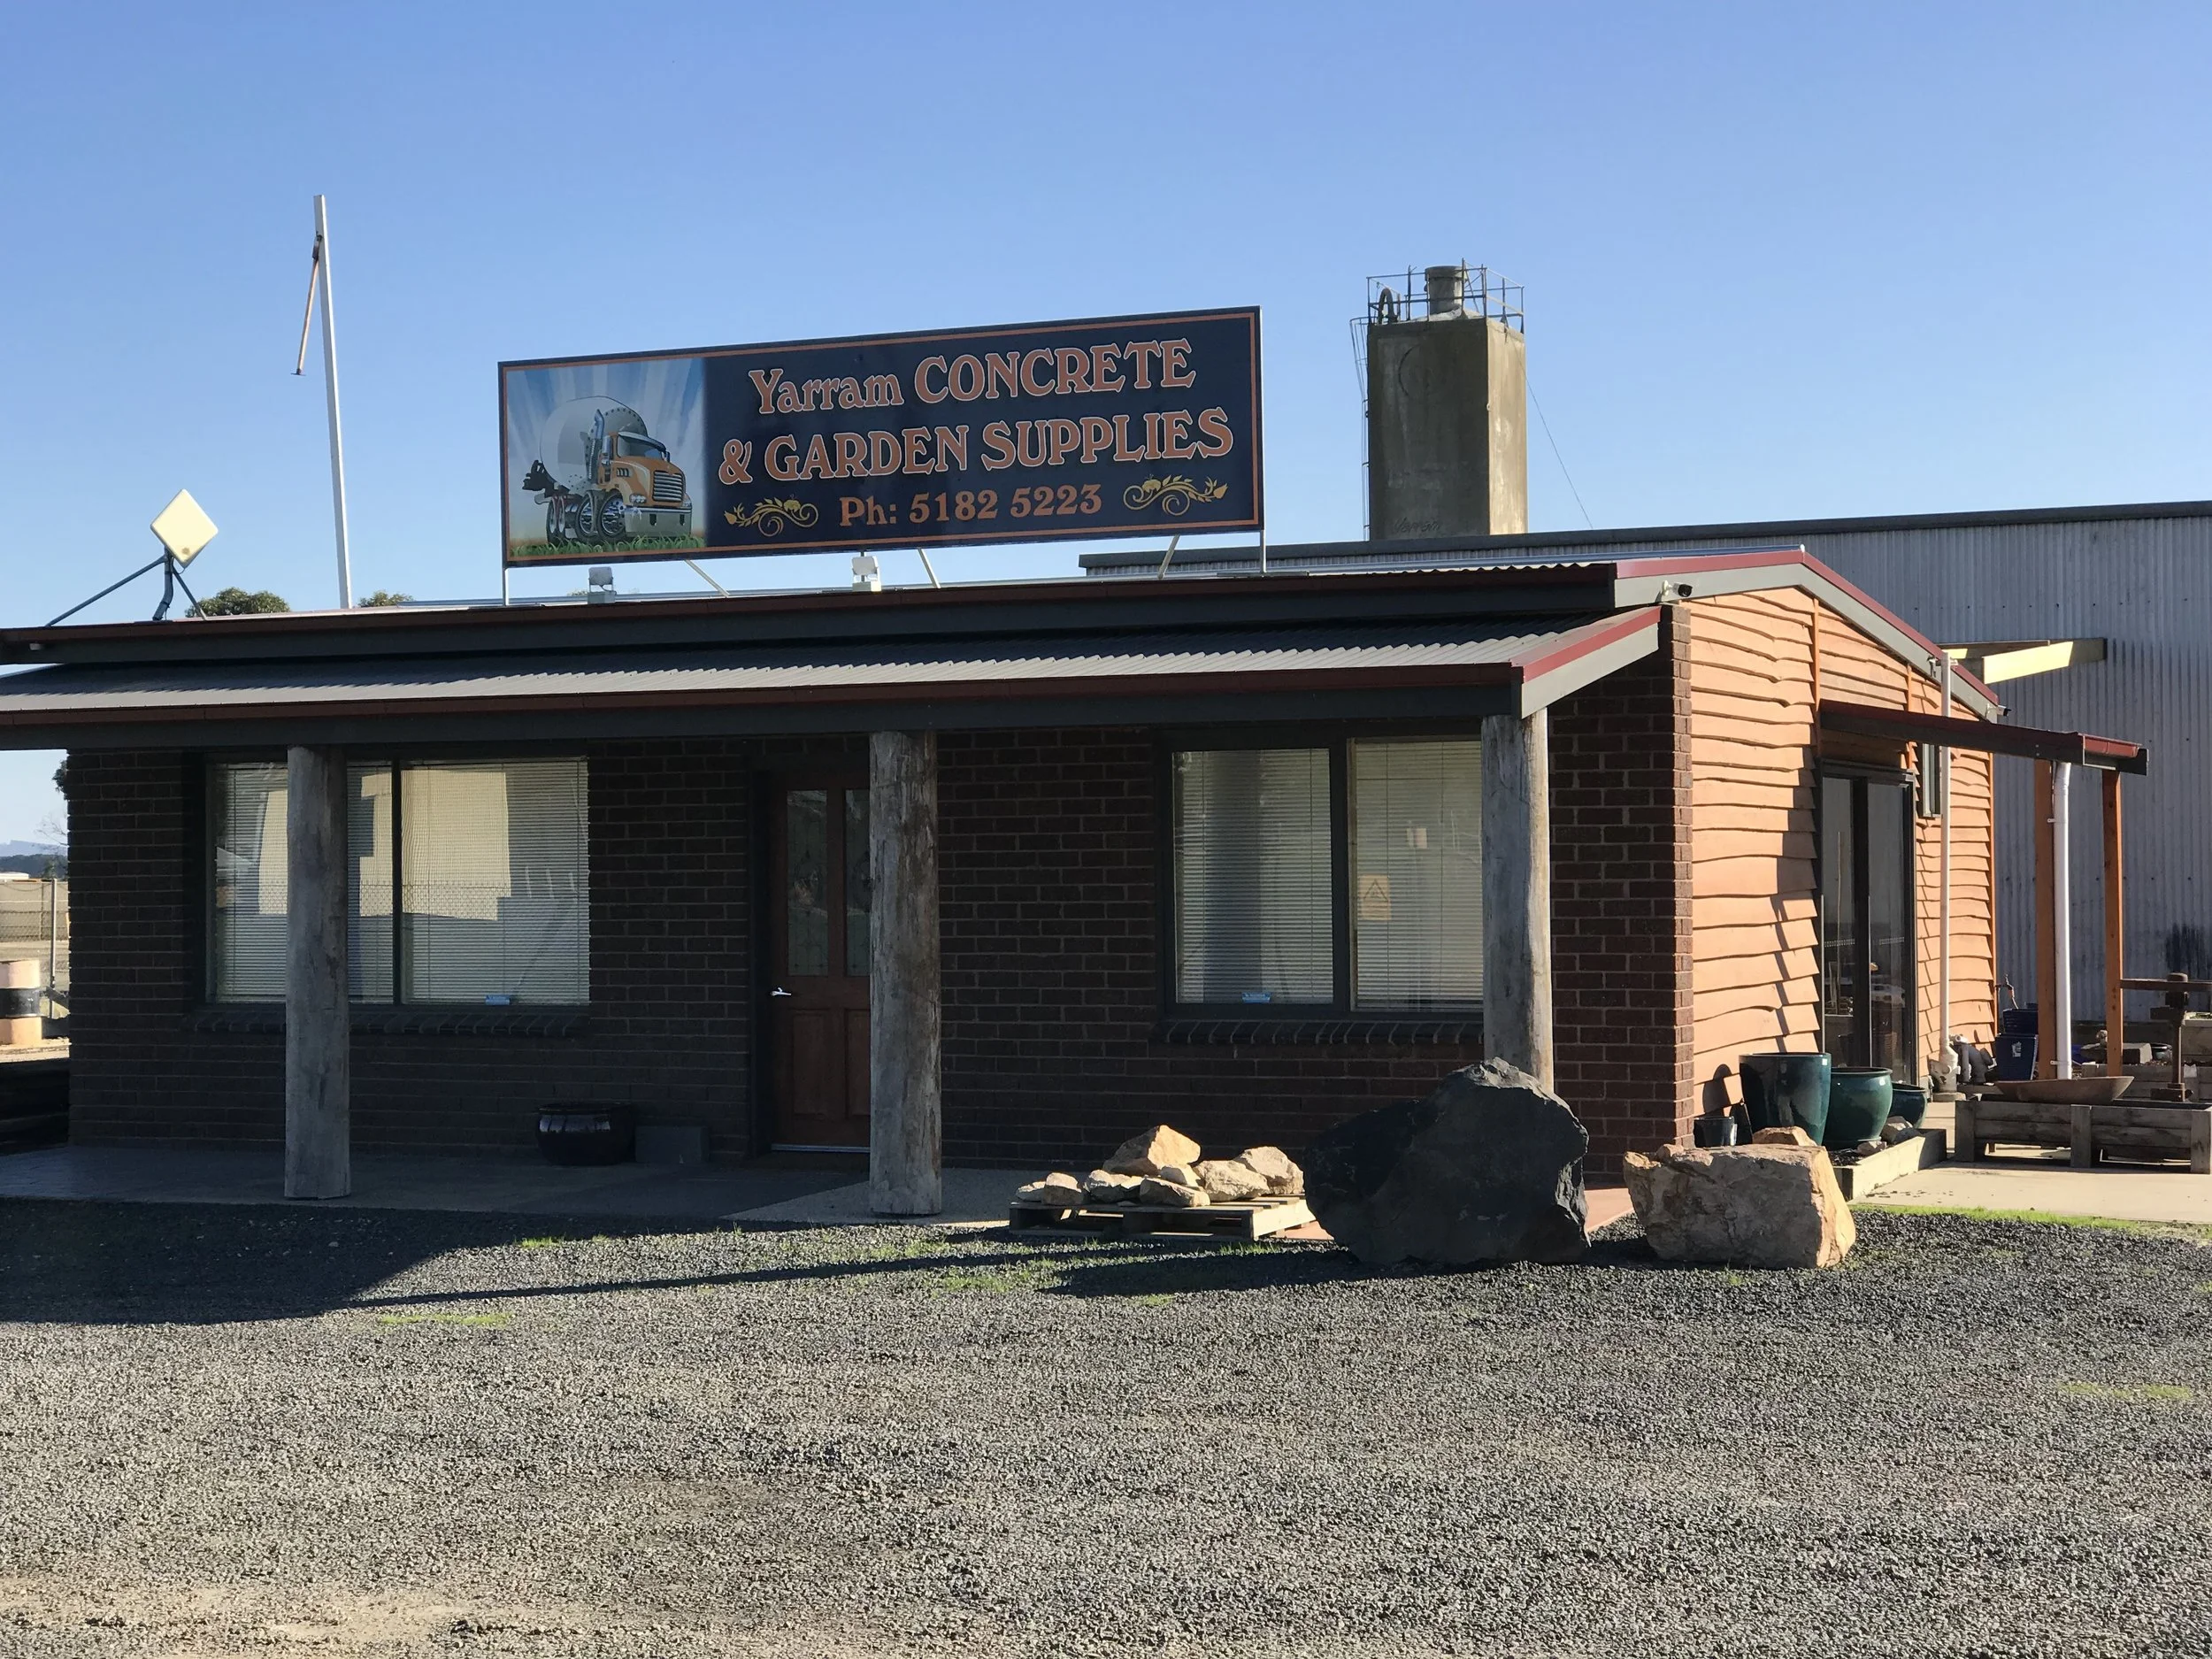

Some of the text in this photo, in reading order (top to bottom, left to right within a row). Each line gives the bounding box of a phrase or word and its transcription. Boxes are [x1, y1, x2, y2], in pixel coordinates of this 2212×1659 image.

[749, 337, 1196, 414] Yarram CONCRETE
[718, 407, 1234, 485] & GARDEN SUPPLIES
[840, 484, 1102, 526] Ph: 5182 5223
